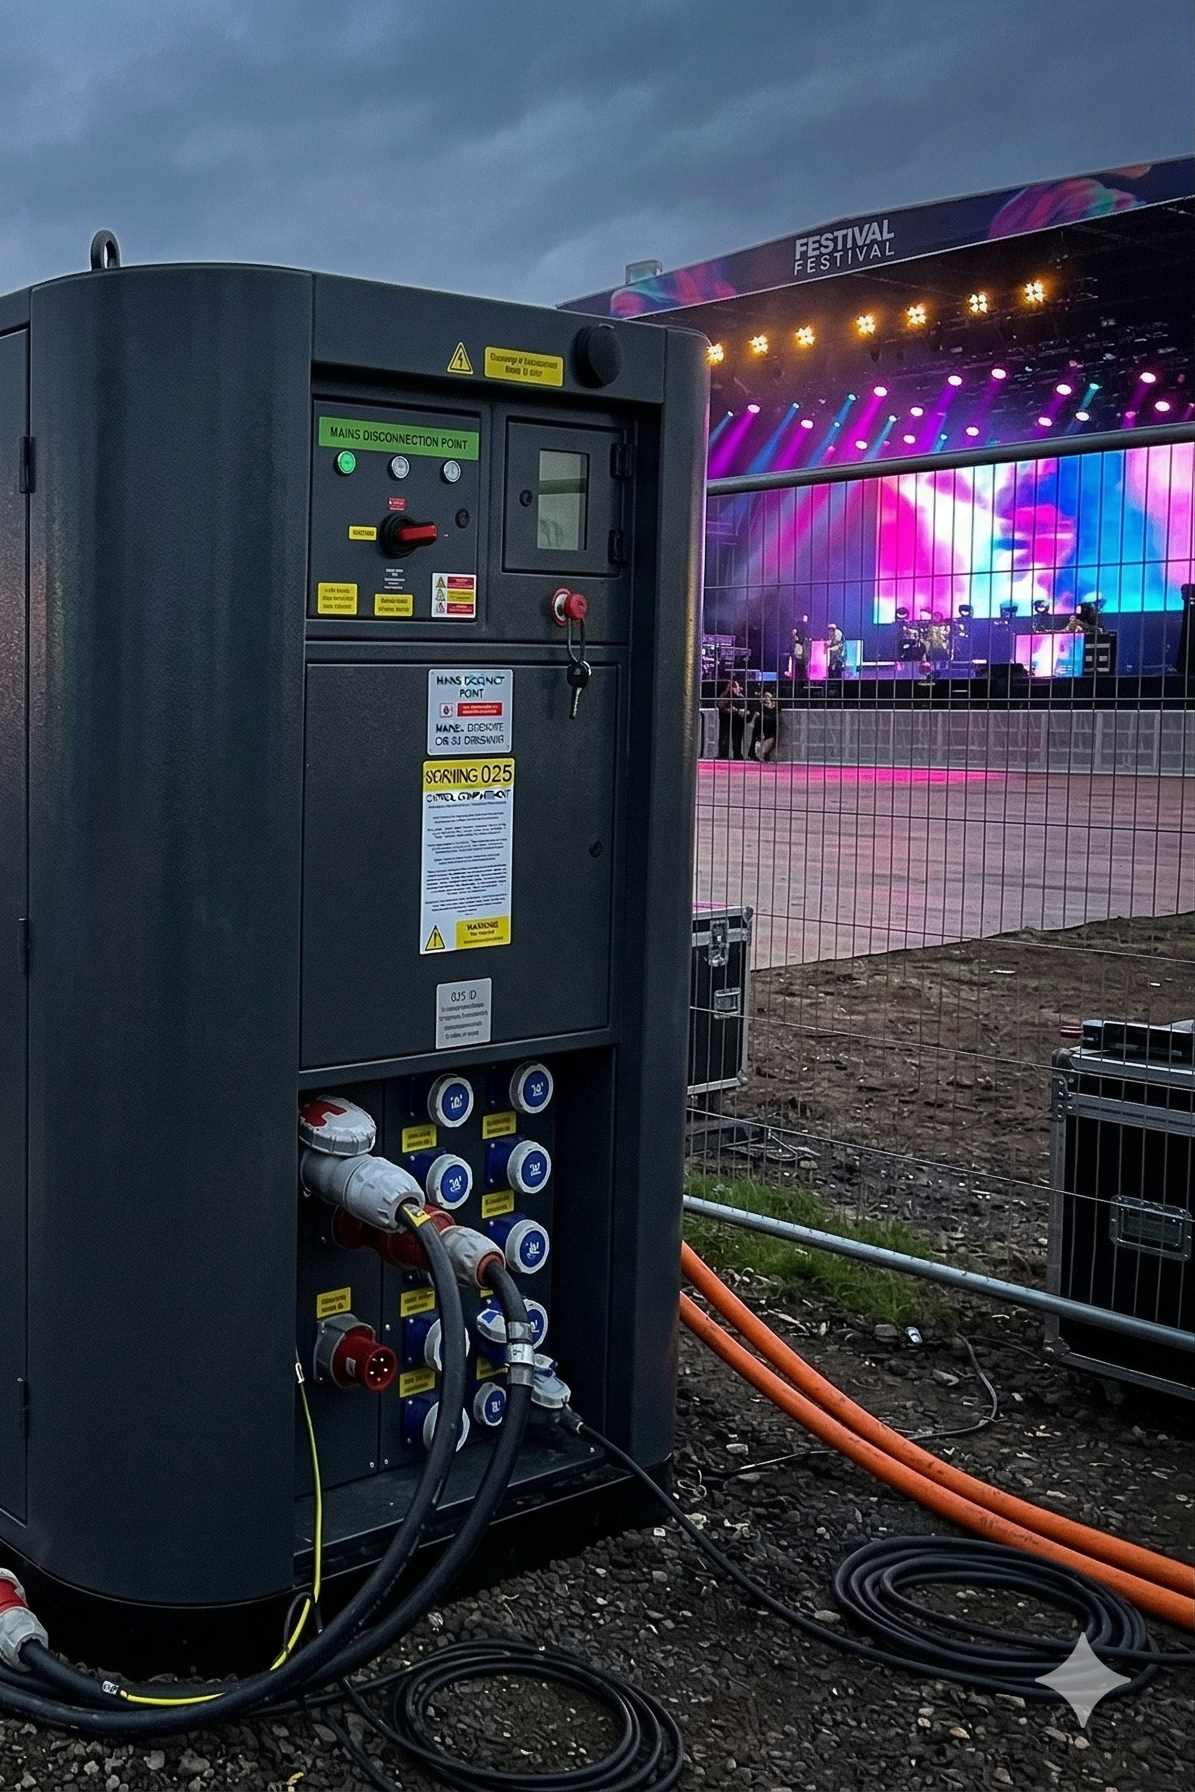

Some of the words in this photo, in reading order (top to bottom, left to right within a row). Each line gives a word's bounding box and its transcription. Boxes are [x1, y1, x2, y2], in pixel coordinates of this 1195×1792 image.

[795, 219, 895, 260] FESTIVAL
[794, 241, 895, 276] FESTIVAL
[330, 426, 361, 440] MAINS
[362, 430, 439, 448] DISCONNECTION
[441, 437, 468, 450] POINT
[481, 764, 513, 784] 025
